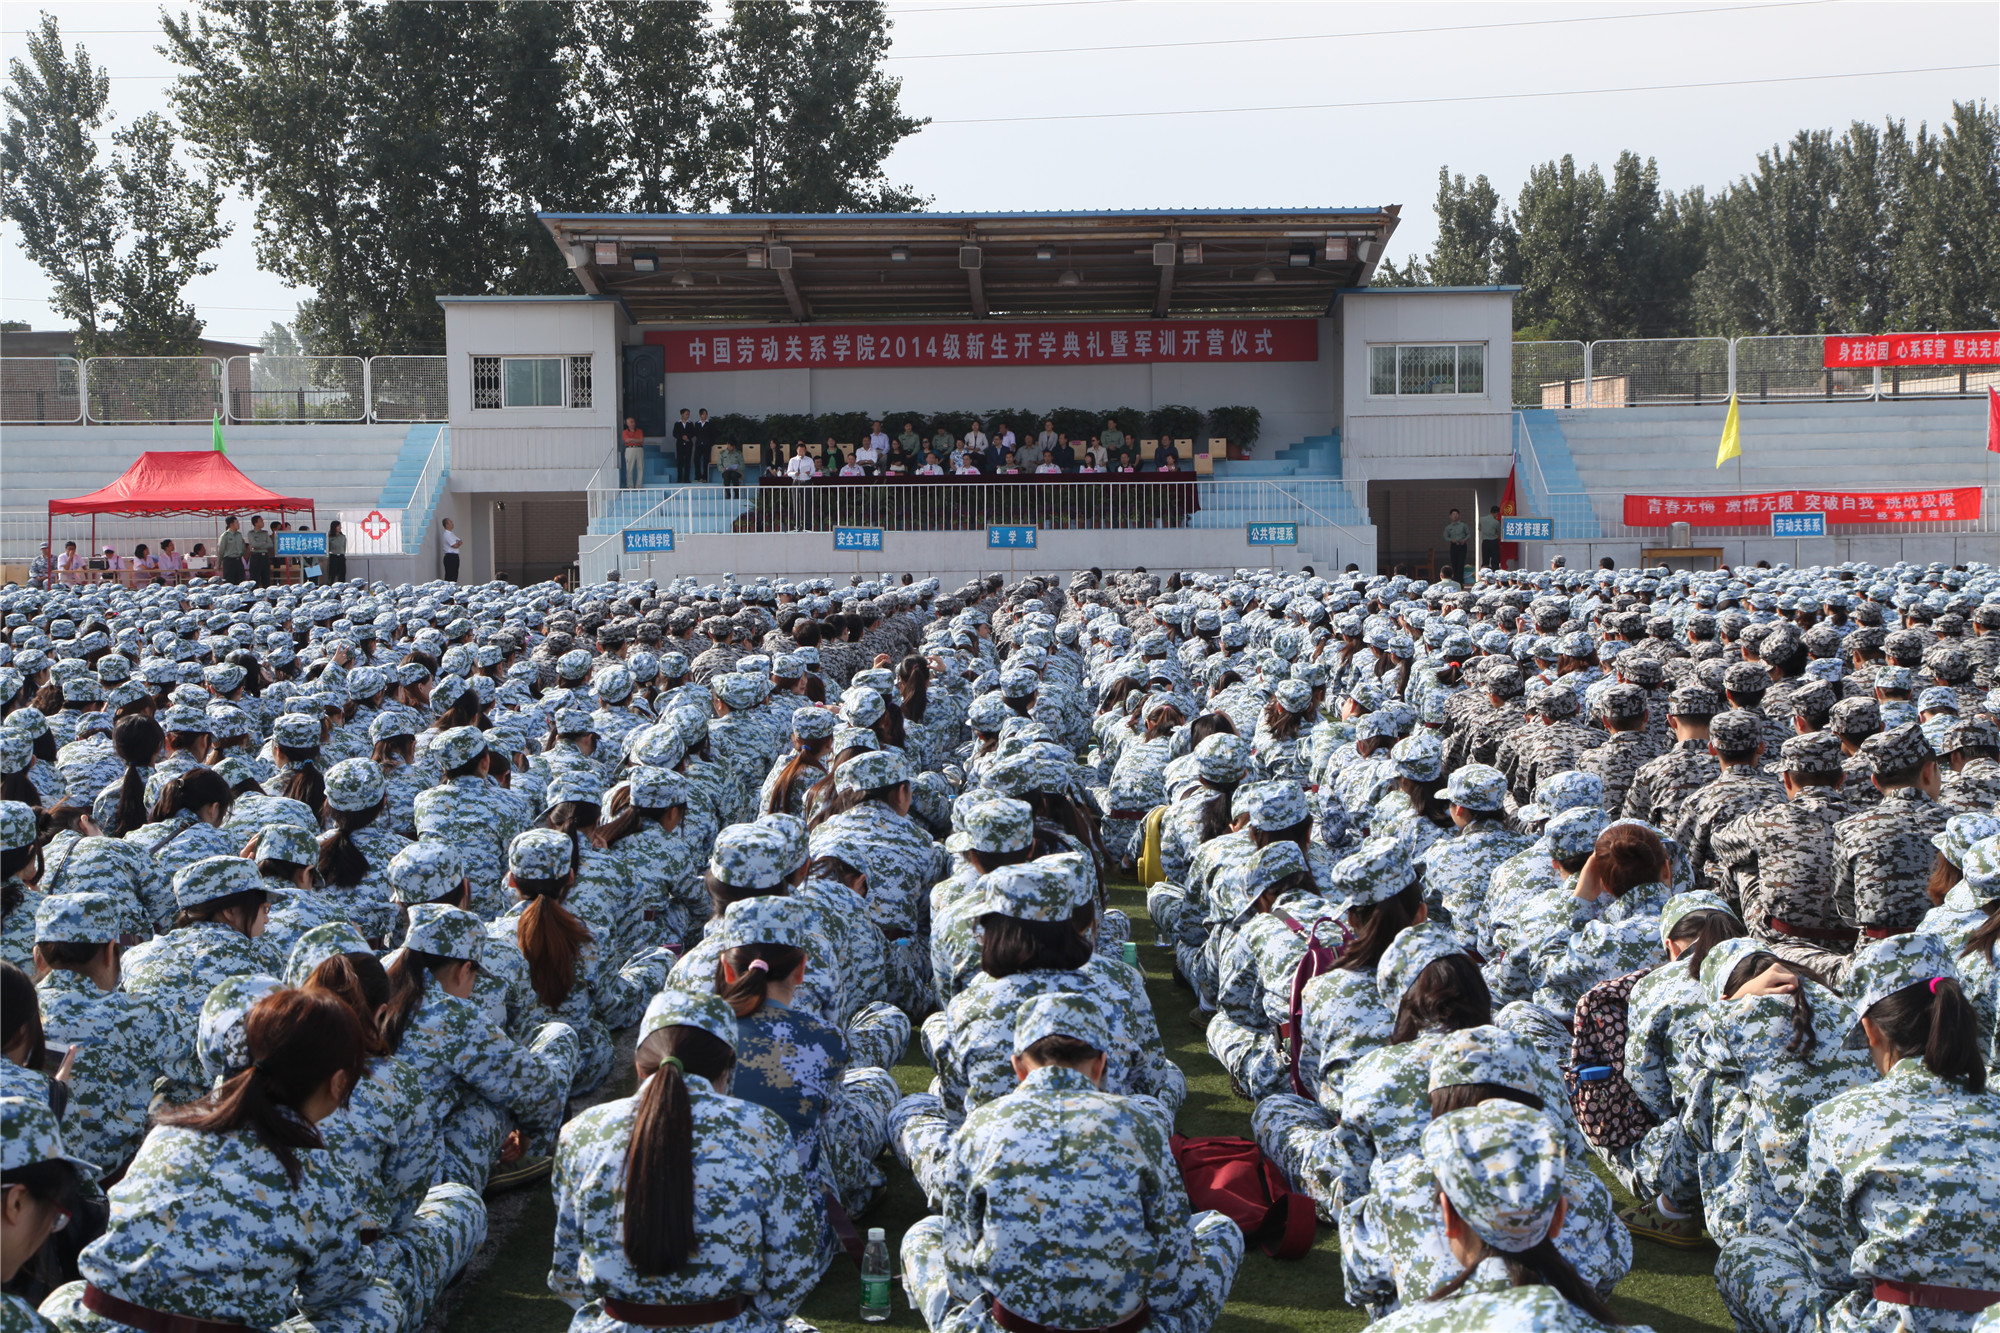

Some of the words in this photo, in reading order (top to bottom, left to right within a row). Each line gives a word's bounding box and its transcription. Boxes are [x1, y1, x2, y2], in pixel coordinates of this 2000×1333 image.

[688, 328, 1274, 365] 中国劳动关系学院2014级新生开学典礼暨军训开营仪式
[1838, 342, 1890, 362] 身在校园
[1896, 339, 1947, 359] 心系军营
[1648, 498, 1716, 514] 青春无悔
[1725, 495, 1794, 513] 激情无限
[1805, 494, 1875, 511] 突破自我
[1885, 492, 1956, 510] 挑战极限
[1506, 522, 1549, 536] 经济管理系
[1776, 518, 1821, 532] 劳动关系系
[627, 533, 671, 547] 文化传播学院
[837, 531, 880, 546] 安全工程系
[1251, 526, 1294, 541] 公共管理系
